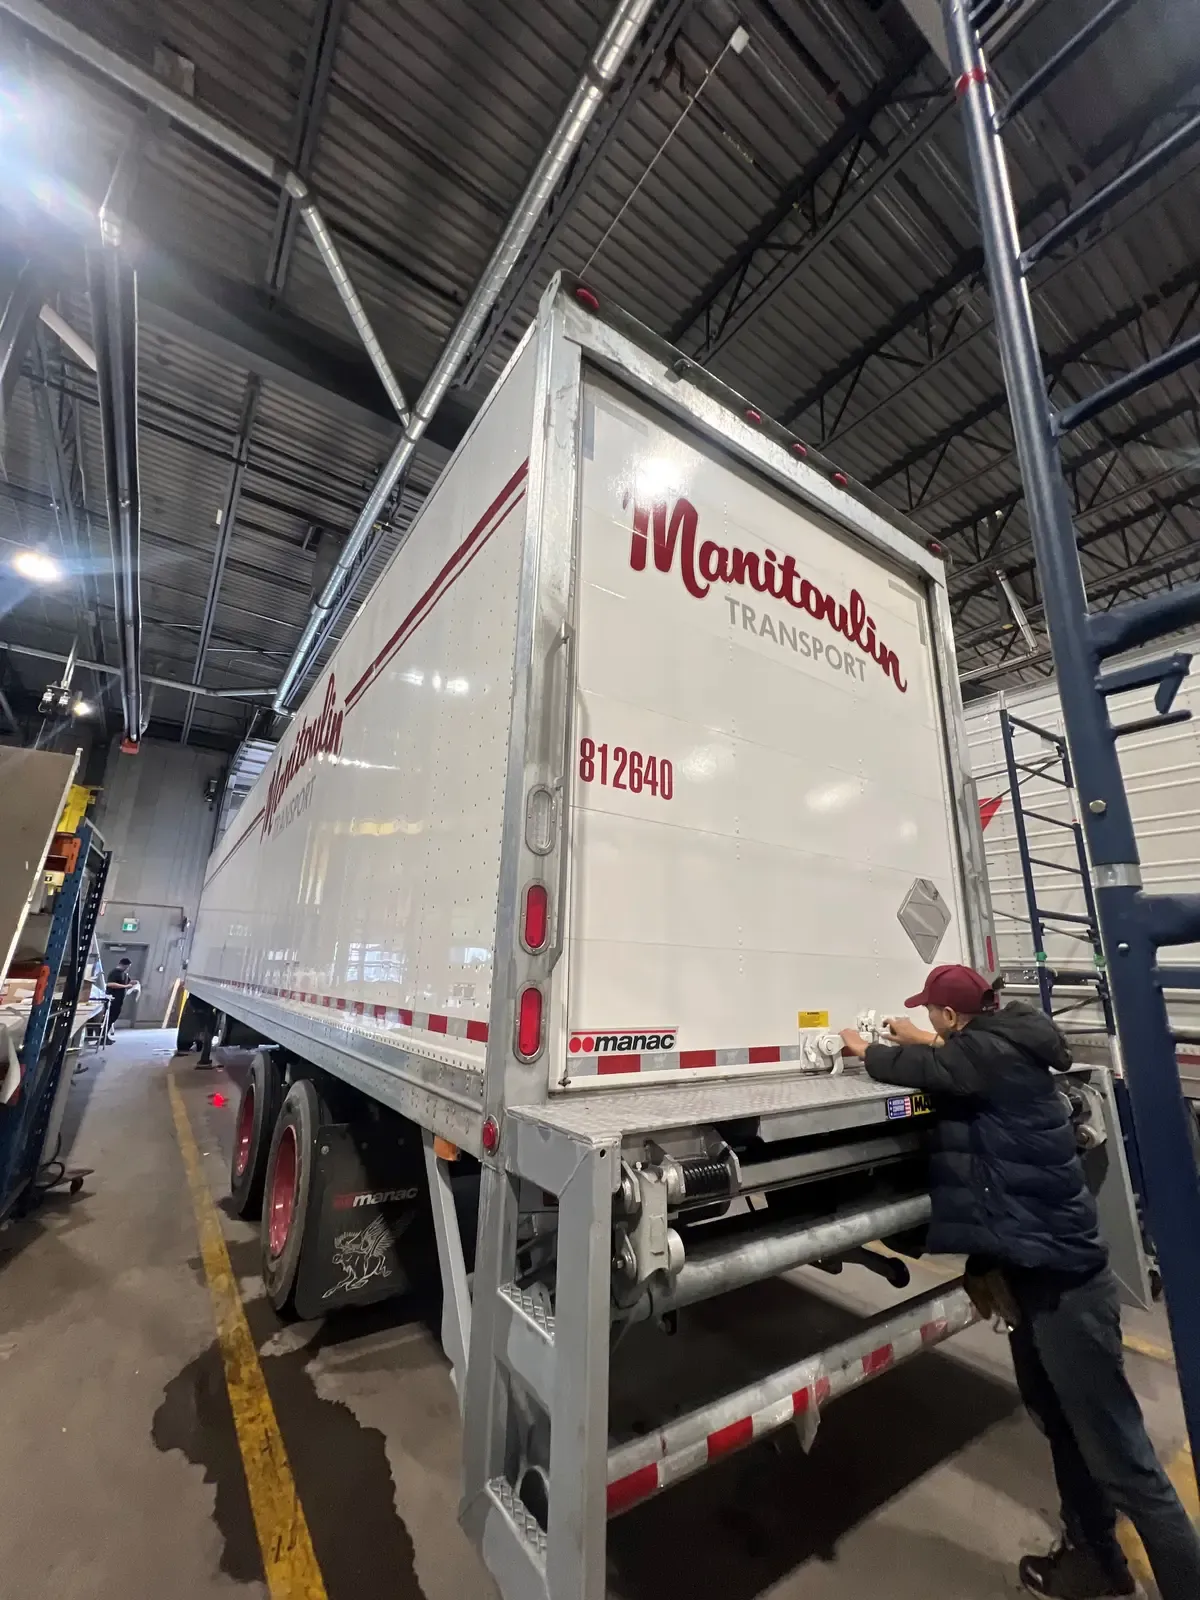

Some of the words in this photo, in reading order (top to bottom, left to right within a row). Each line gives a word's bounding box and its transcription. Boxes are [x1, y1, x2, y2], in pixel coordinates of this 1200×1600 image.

[622, 489, 907, 693] Manitoulin
[724, 596, 866, 682] TRANSPORT
[580, 738, 673, 800] 812640
[594, 1034, 675, 1052] manac
[353, 1187, 418, 1207] manac
